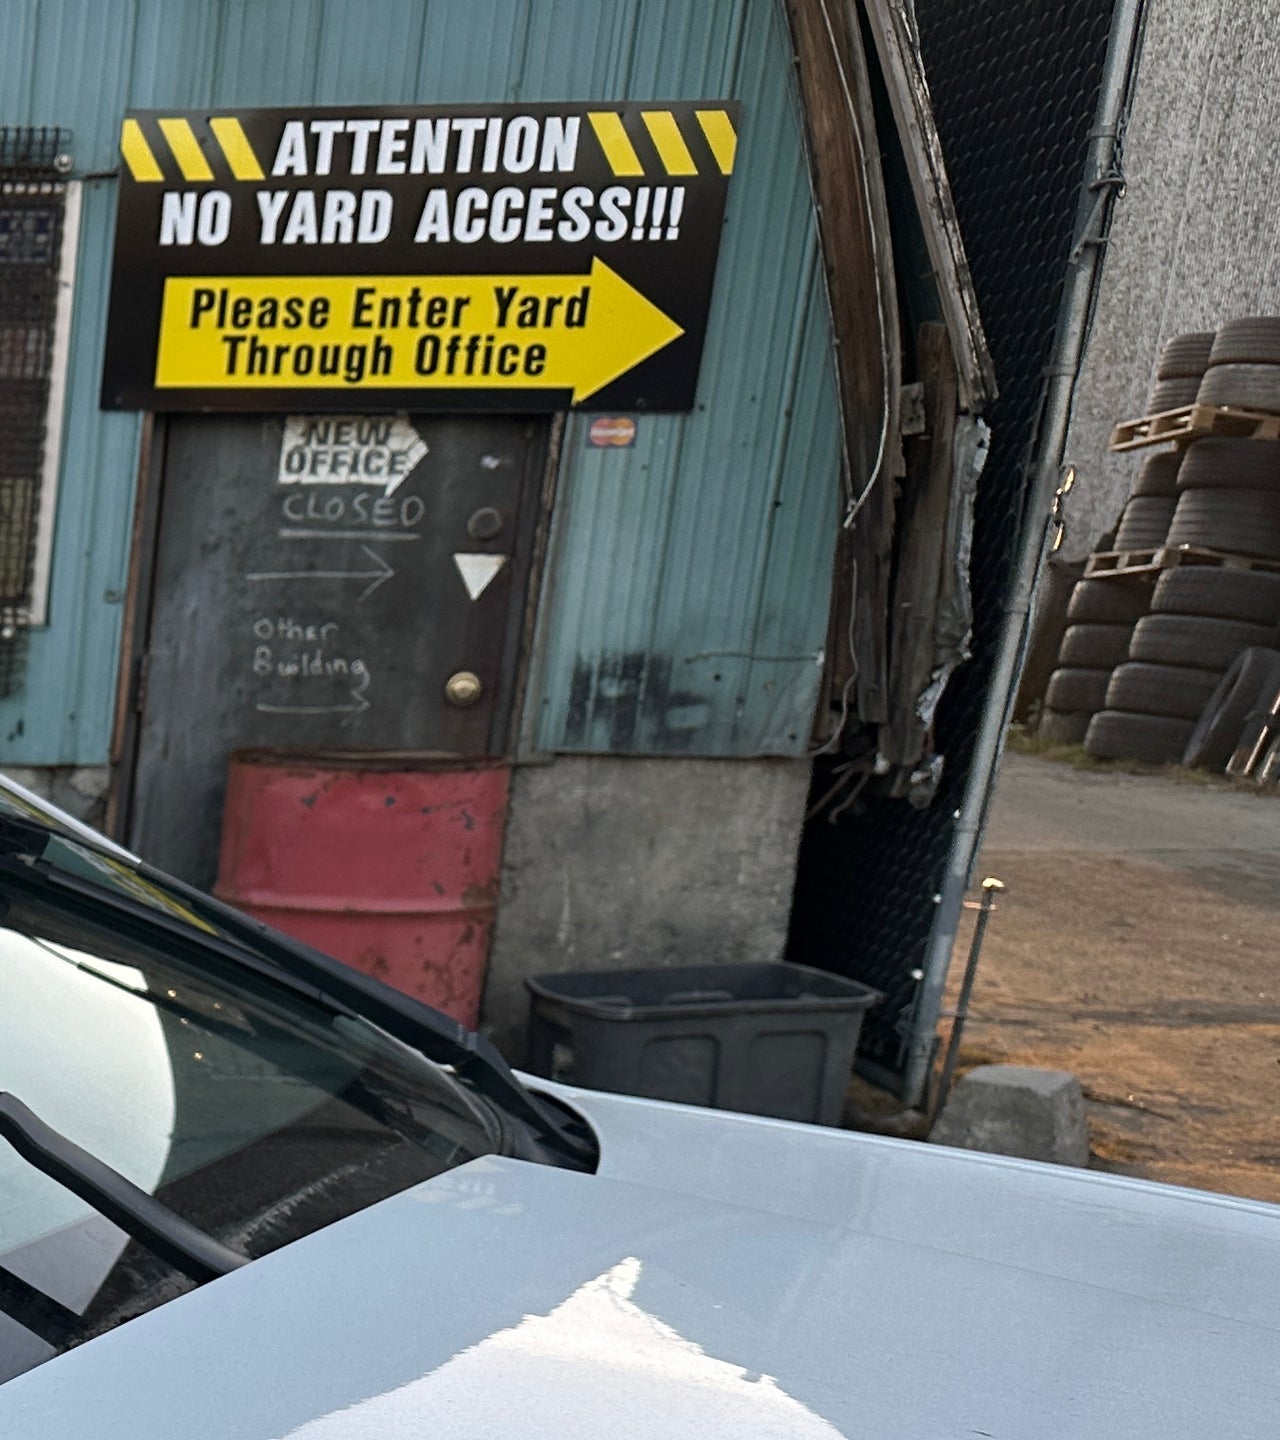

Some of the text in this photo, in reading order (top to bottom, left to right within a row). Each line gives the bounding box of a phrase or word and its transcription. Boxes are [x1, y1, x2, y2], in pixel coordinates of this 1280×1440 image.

[271, 115, 581, 177] ATTENTION
[159, 185, 686, 246] NO YARD ACCESS!!!
[190, 286, 591, 329] Please Enter Yard
[222, 333, 547, 383] Through Office
[305, 417, 391, 446] NEW
[284, 446, 410, 476] OFFICE
[282, 491, 425, 527] CLOSED
[253, 617, 339, 641] Other
[253, 644, 371, 693] Building
